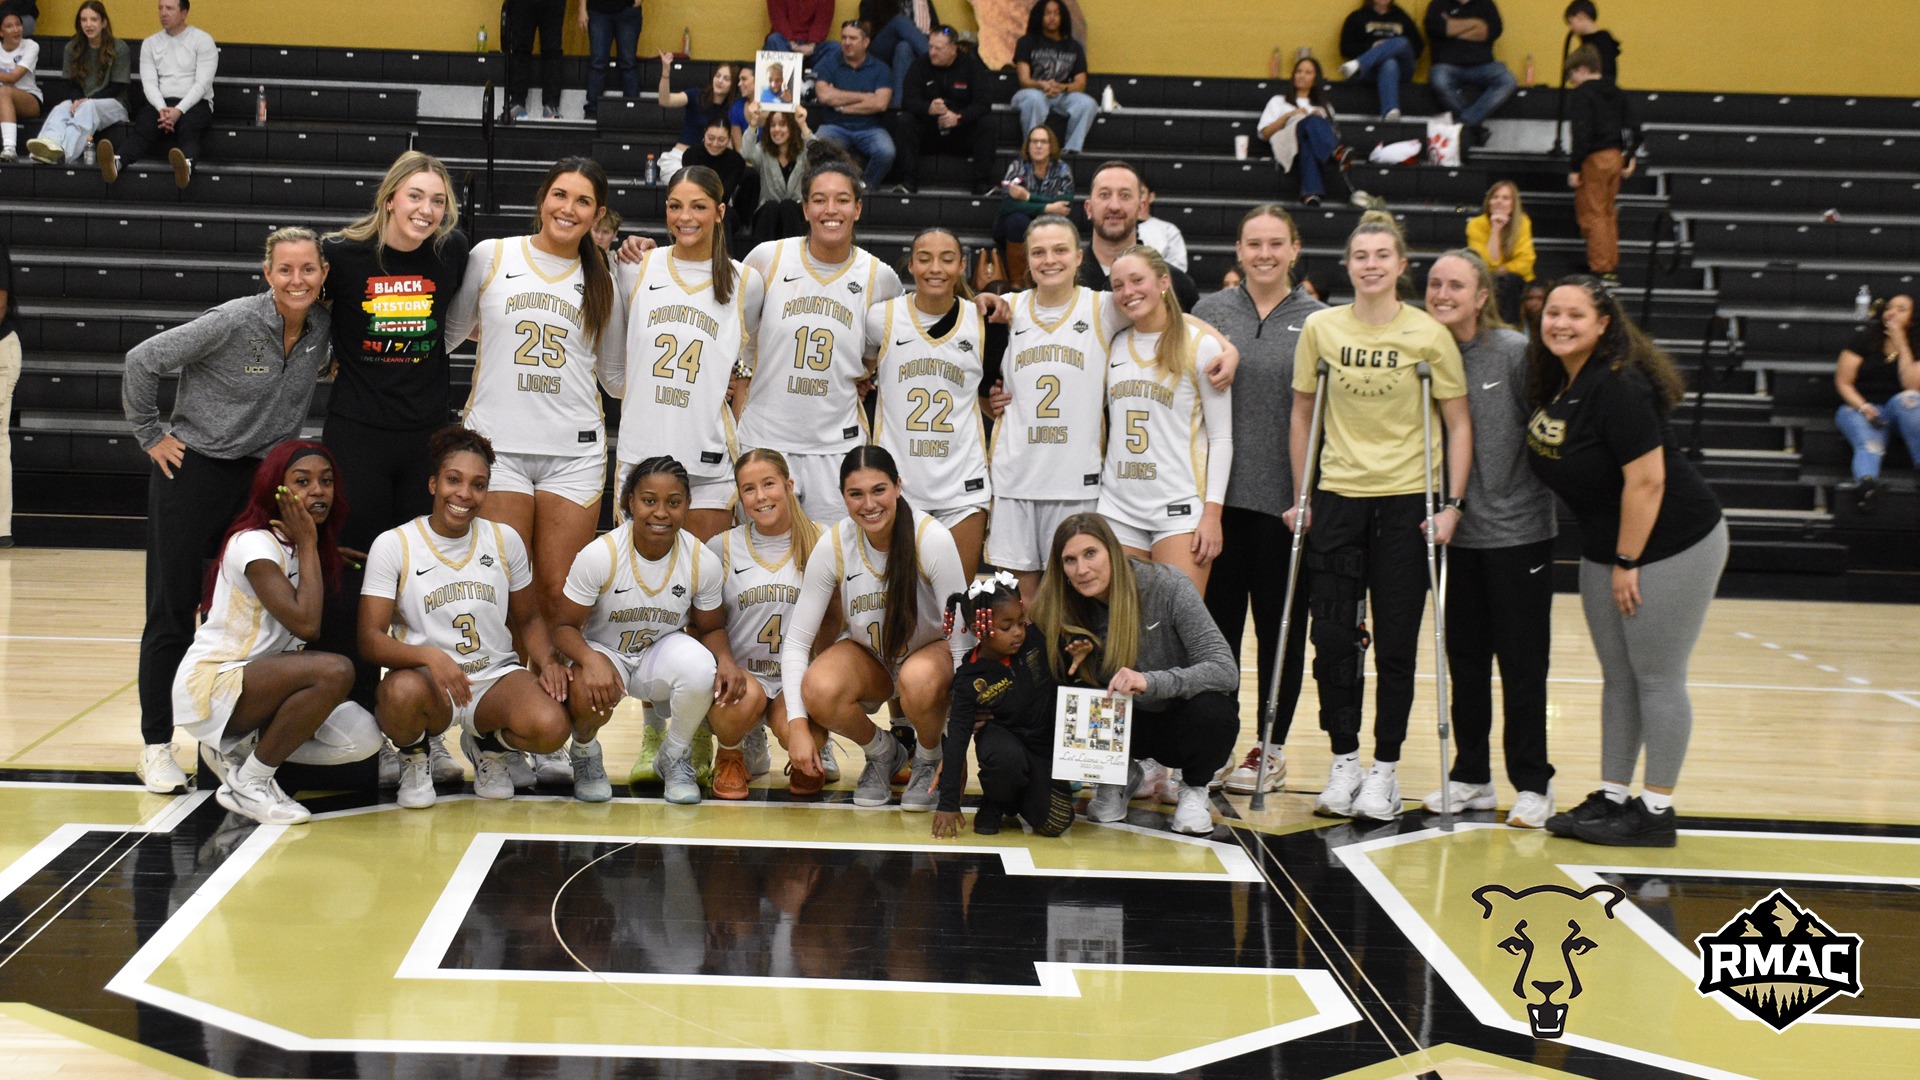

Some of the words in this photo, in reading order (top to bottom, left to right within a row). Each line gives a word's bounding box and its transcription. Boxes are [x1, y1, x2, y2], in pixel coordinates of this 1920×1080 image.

[374, 280, 422, 294] BLACK
[373, 300, 430, 312] HISTORY
[782, 296, 853, 330] MOUNTAIN
[374, 320, 427, 332] MONTH
[647, 304, 720, 341] MOUNTAIN
[514, 319, 568, 369] 25
[794, 325, 834, 372] 13
[1340, 346, 1398, 368] UCCS
[244, 365, 270, 374] UCCS
[652, 333, 704, 384] 24
[1014, 344, 1084, 372] MOUNTAIN
[517, 373, 561, 395] LIONS
[787, 375, 829, 397] LIONS
[898, 357, 966, 389] MOUNTAIN
[655, 385, 690, 408] LIONS
[1036, 374, 1060, 418] 2
[1110, 379, 1175, 410] MOUNTAIN
[906, 387, 955, 433] 22
[1028, 425, 1068, 445] LIONS
[1125, 409, 1150, 455] 5
[910, 438, 950, 458] LIONS
[1117, 461, 1157, 481] LIONS
[424, 580, 498, 614] MOUNTAIN
[608, 606, 681, 627] MOUNTAIN
[452, 613, 480, 656] 3
[617, 628, 660, 654] 15
[757, 614, 782, 654] 4
[747, 658, 782, 678] LION
